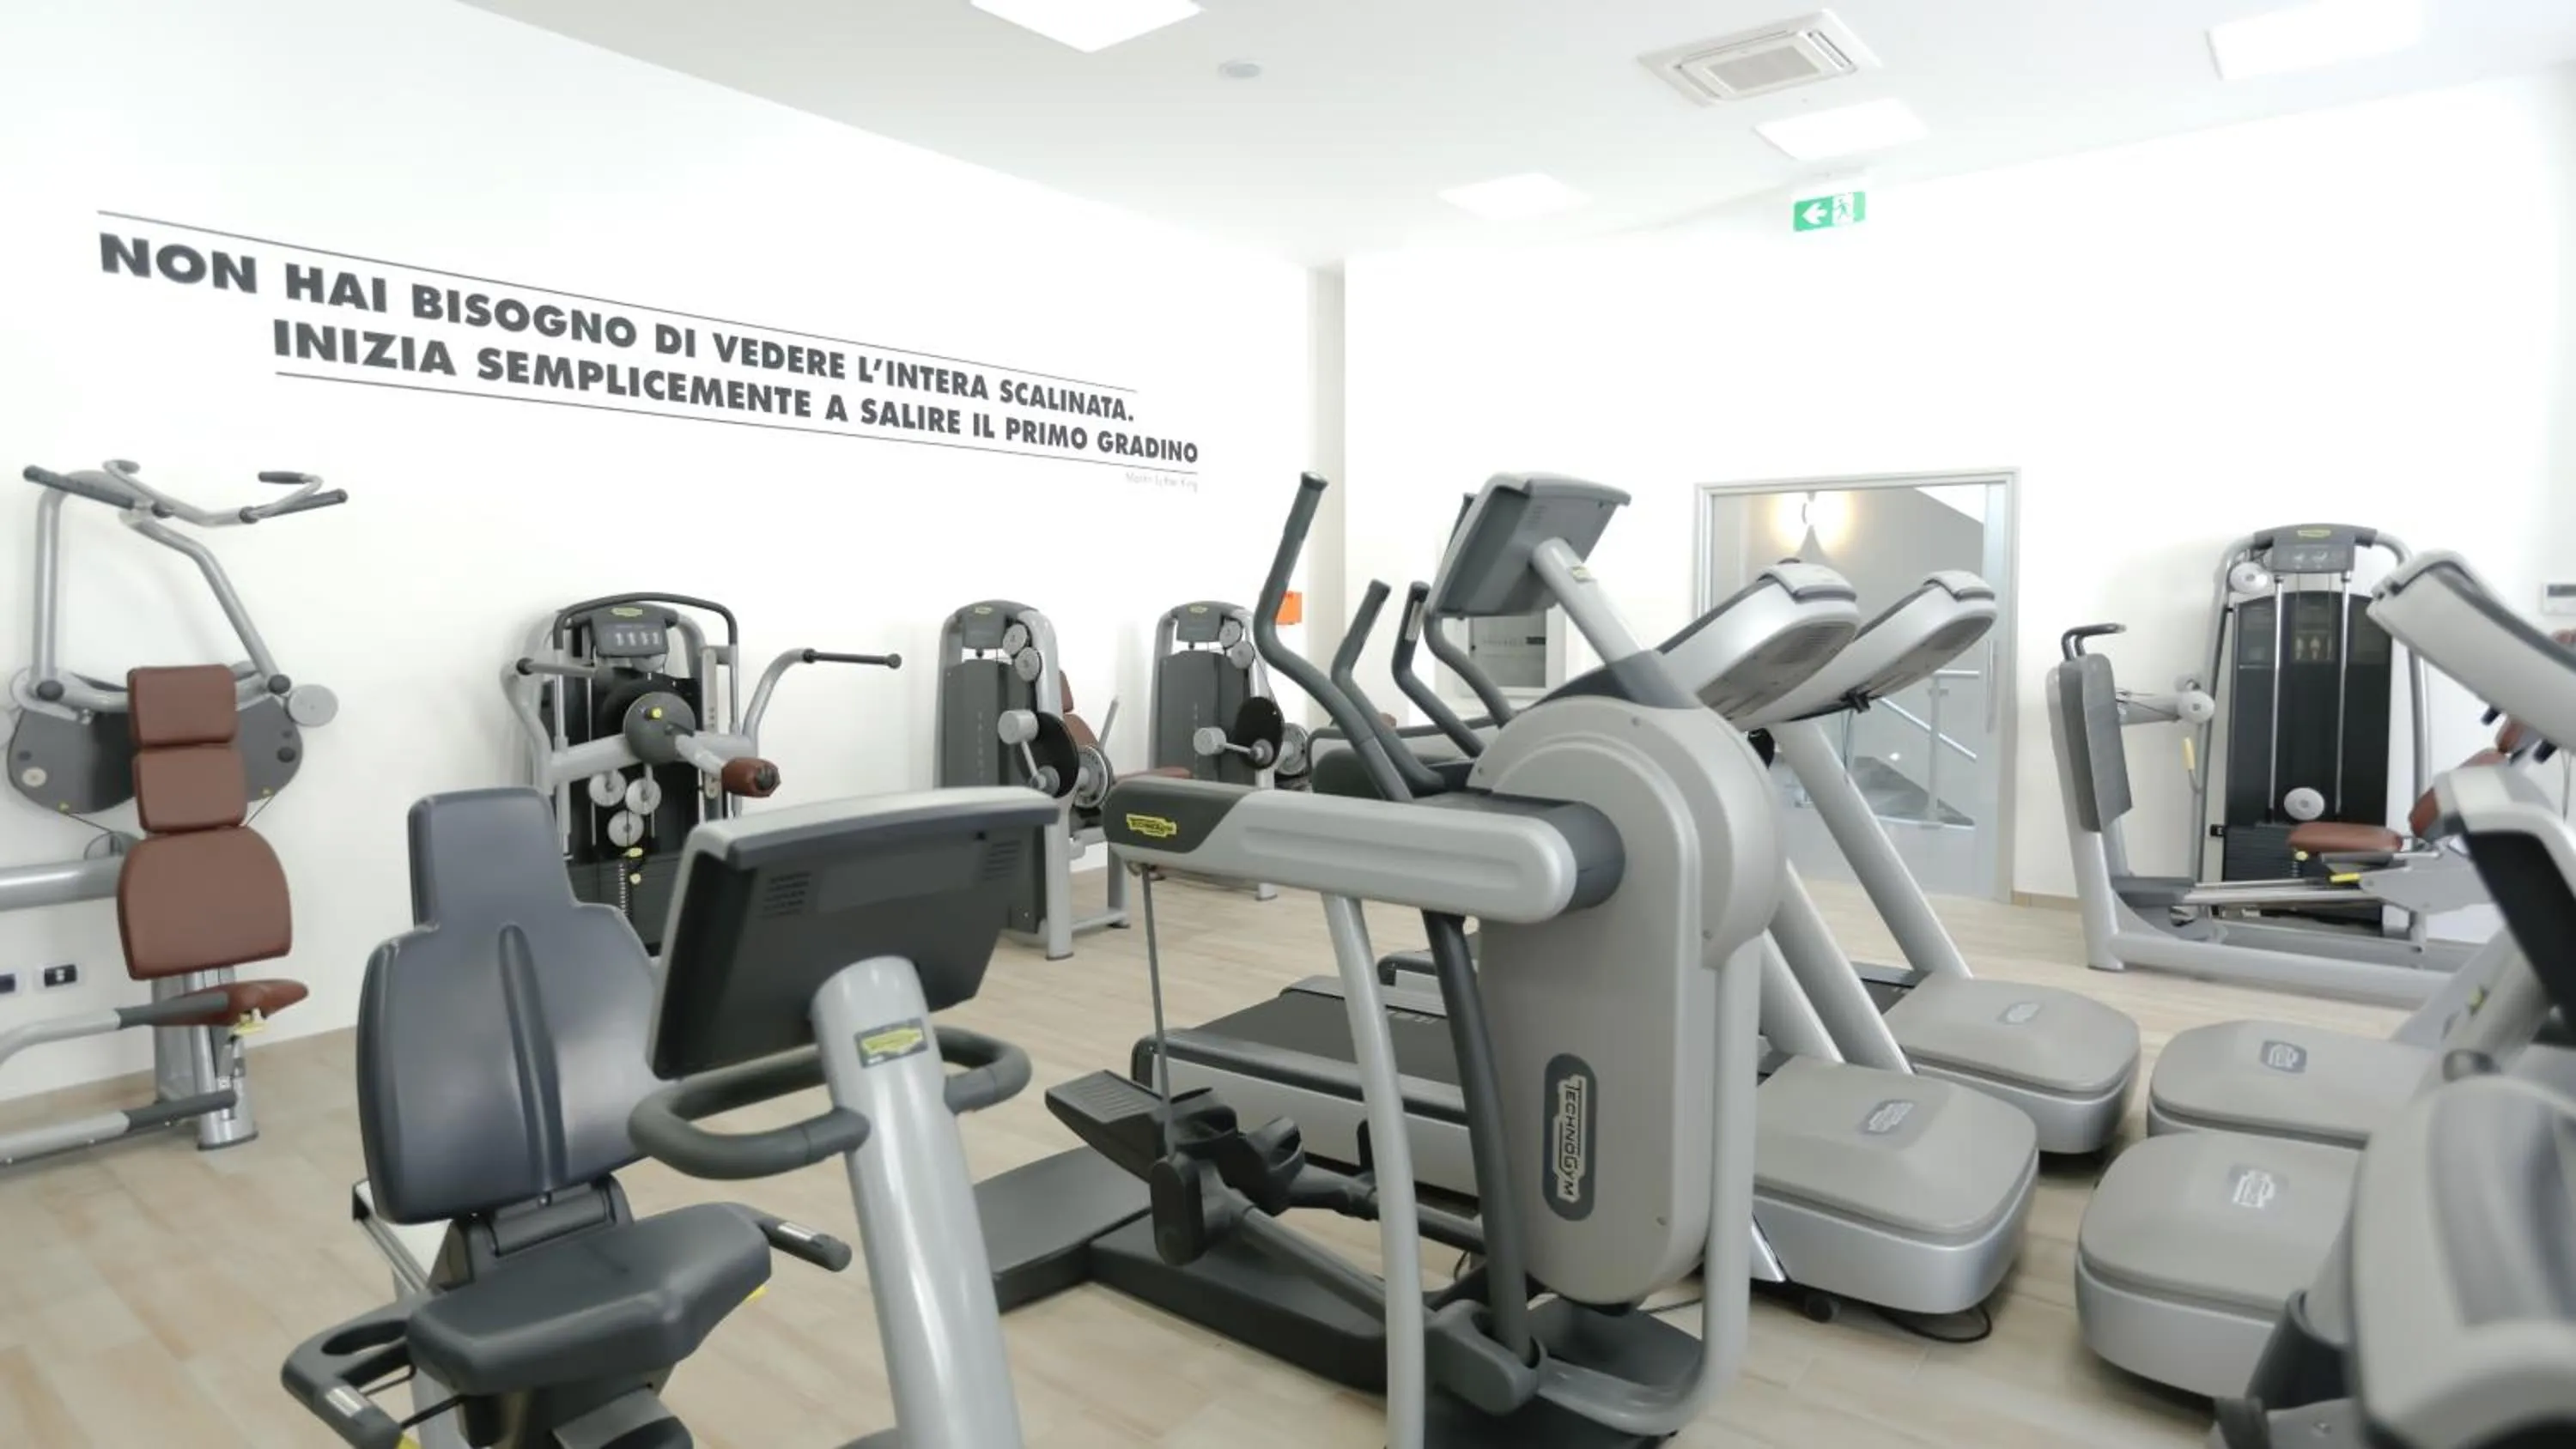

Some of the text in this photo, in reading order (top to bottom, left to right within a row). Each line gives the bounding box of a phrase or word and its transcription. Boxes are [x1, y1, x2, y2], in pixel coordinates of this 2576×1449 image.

[100, 233, 1135, 422] NON HAI BISOGNO DI VEDERE L'INTERA SCALINATA.
[274, 318, 1198, 464] INIZIA SEMPLICEMENTE A SALIRE IL PRIMO GRADINO
[1558, 1079, 1583, 1197] TECHNOGYM
